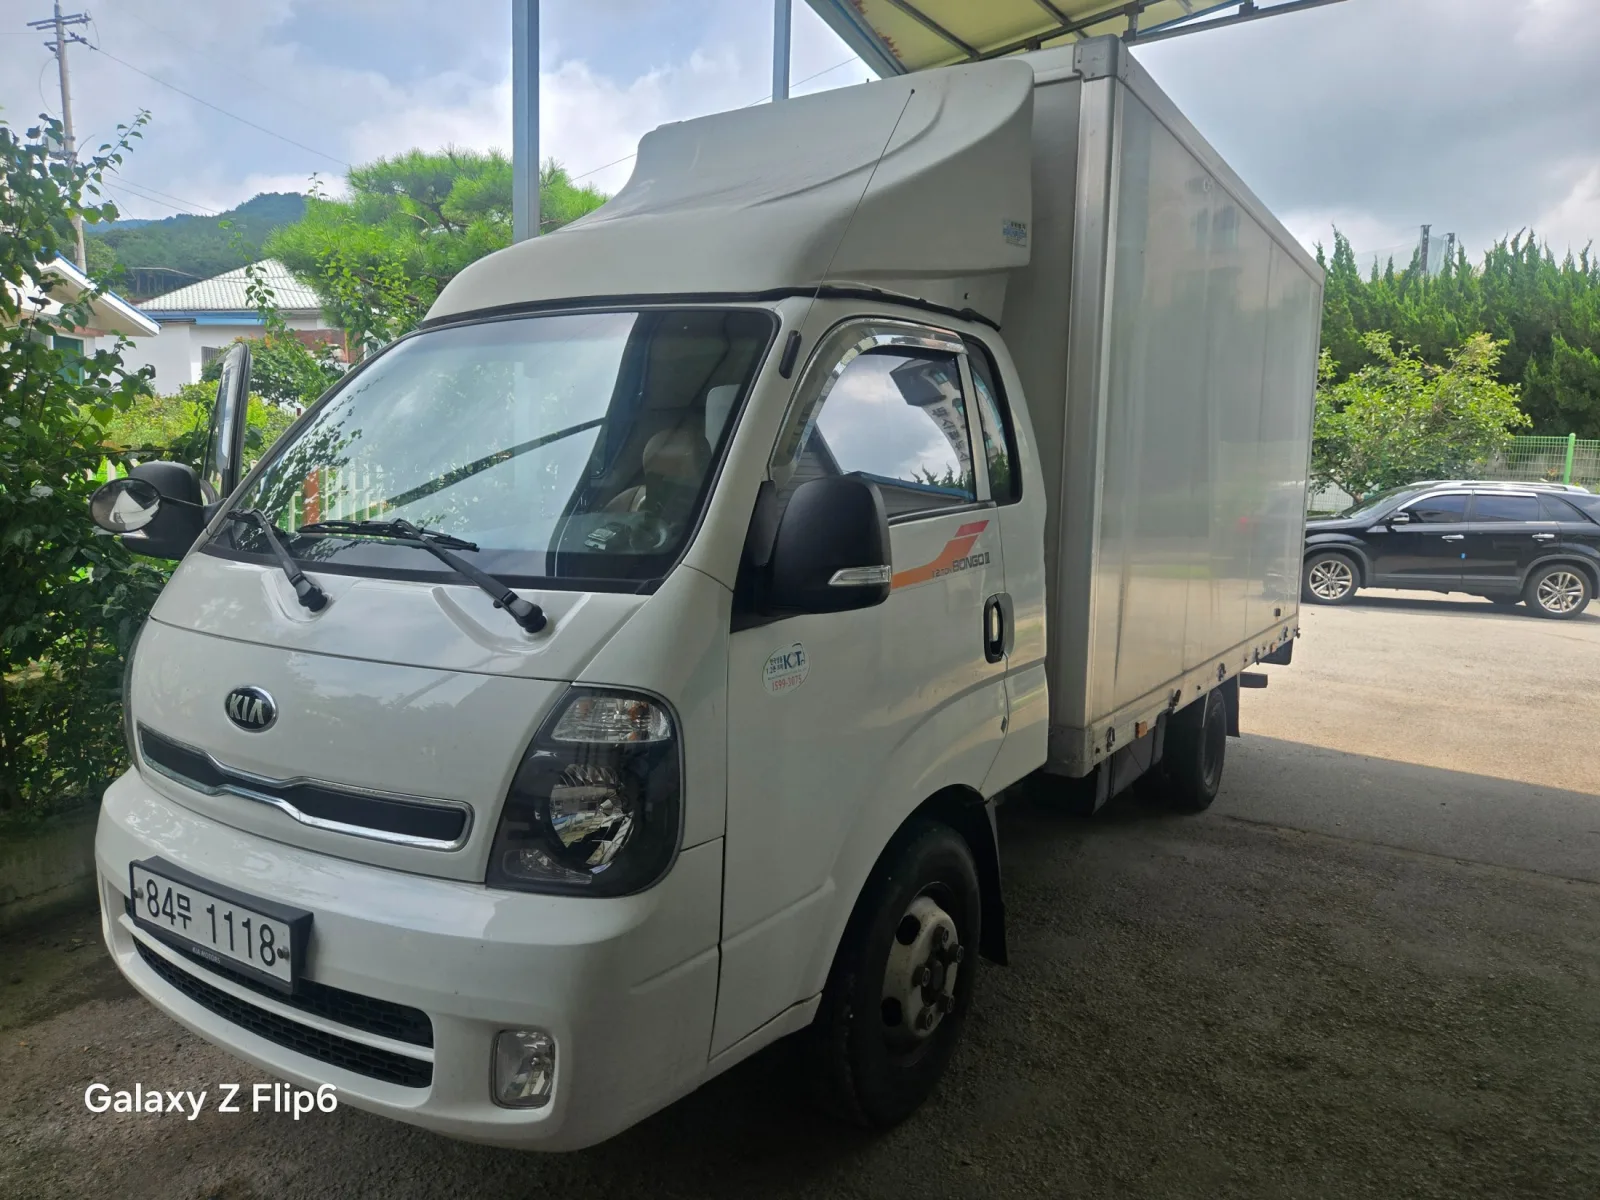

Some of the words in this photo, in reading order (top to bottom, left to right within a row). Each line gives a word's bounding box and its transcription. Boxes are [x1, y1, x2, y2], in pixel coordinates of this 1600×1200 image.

[952, 553, 984, 573] BONGO
[229, 693, 265, 725] KIA
[206, 903, 276, 967] 1118
